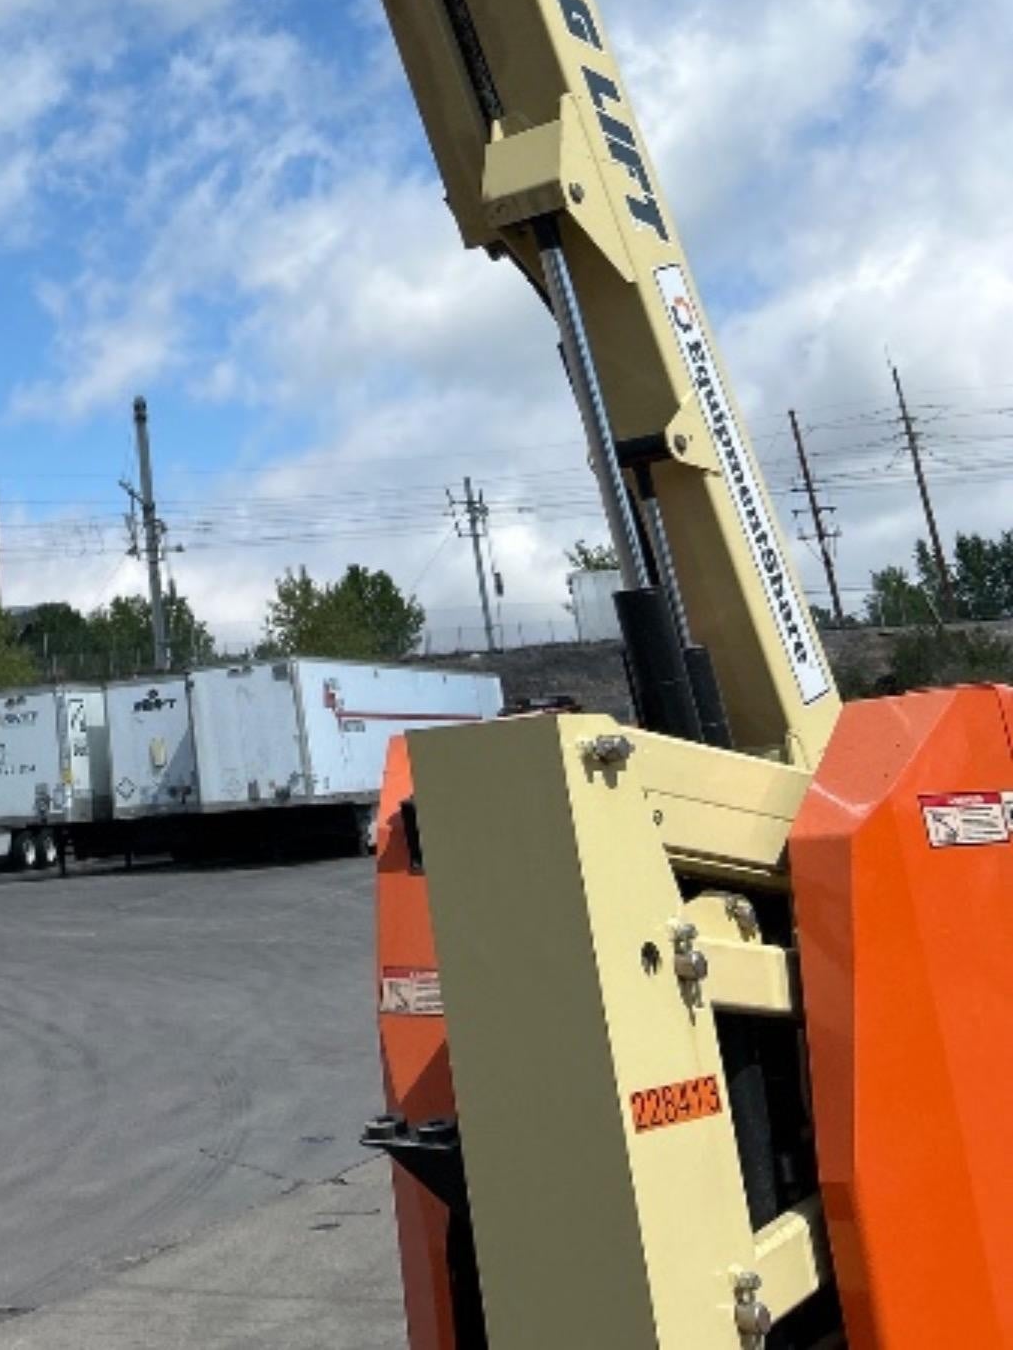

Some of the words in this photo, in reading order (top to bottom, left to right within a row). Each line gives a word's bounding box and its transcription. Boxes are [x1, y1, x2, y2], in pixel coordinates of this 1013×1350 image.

[581, 64, 670, 243] LIFT
[685, 340, 809, 666] EquipmentShare
[630, 1074, 721, 1130] 228413
